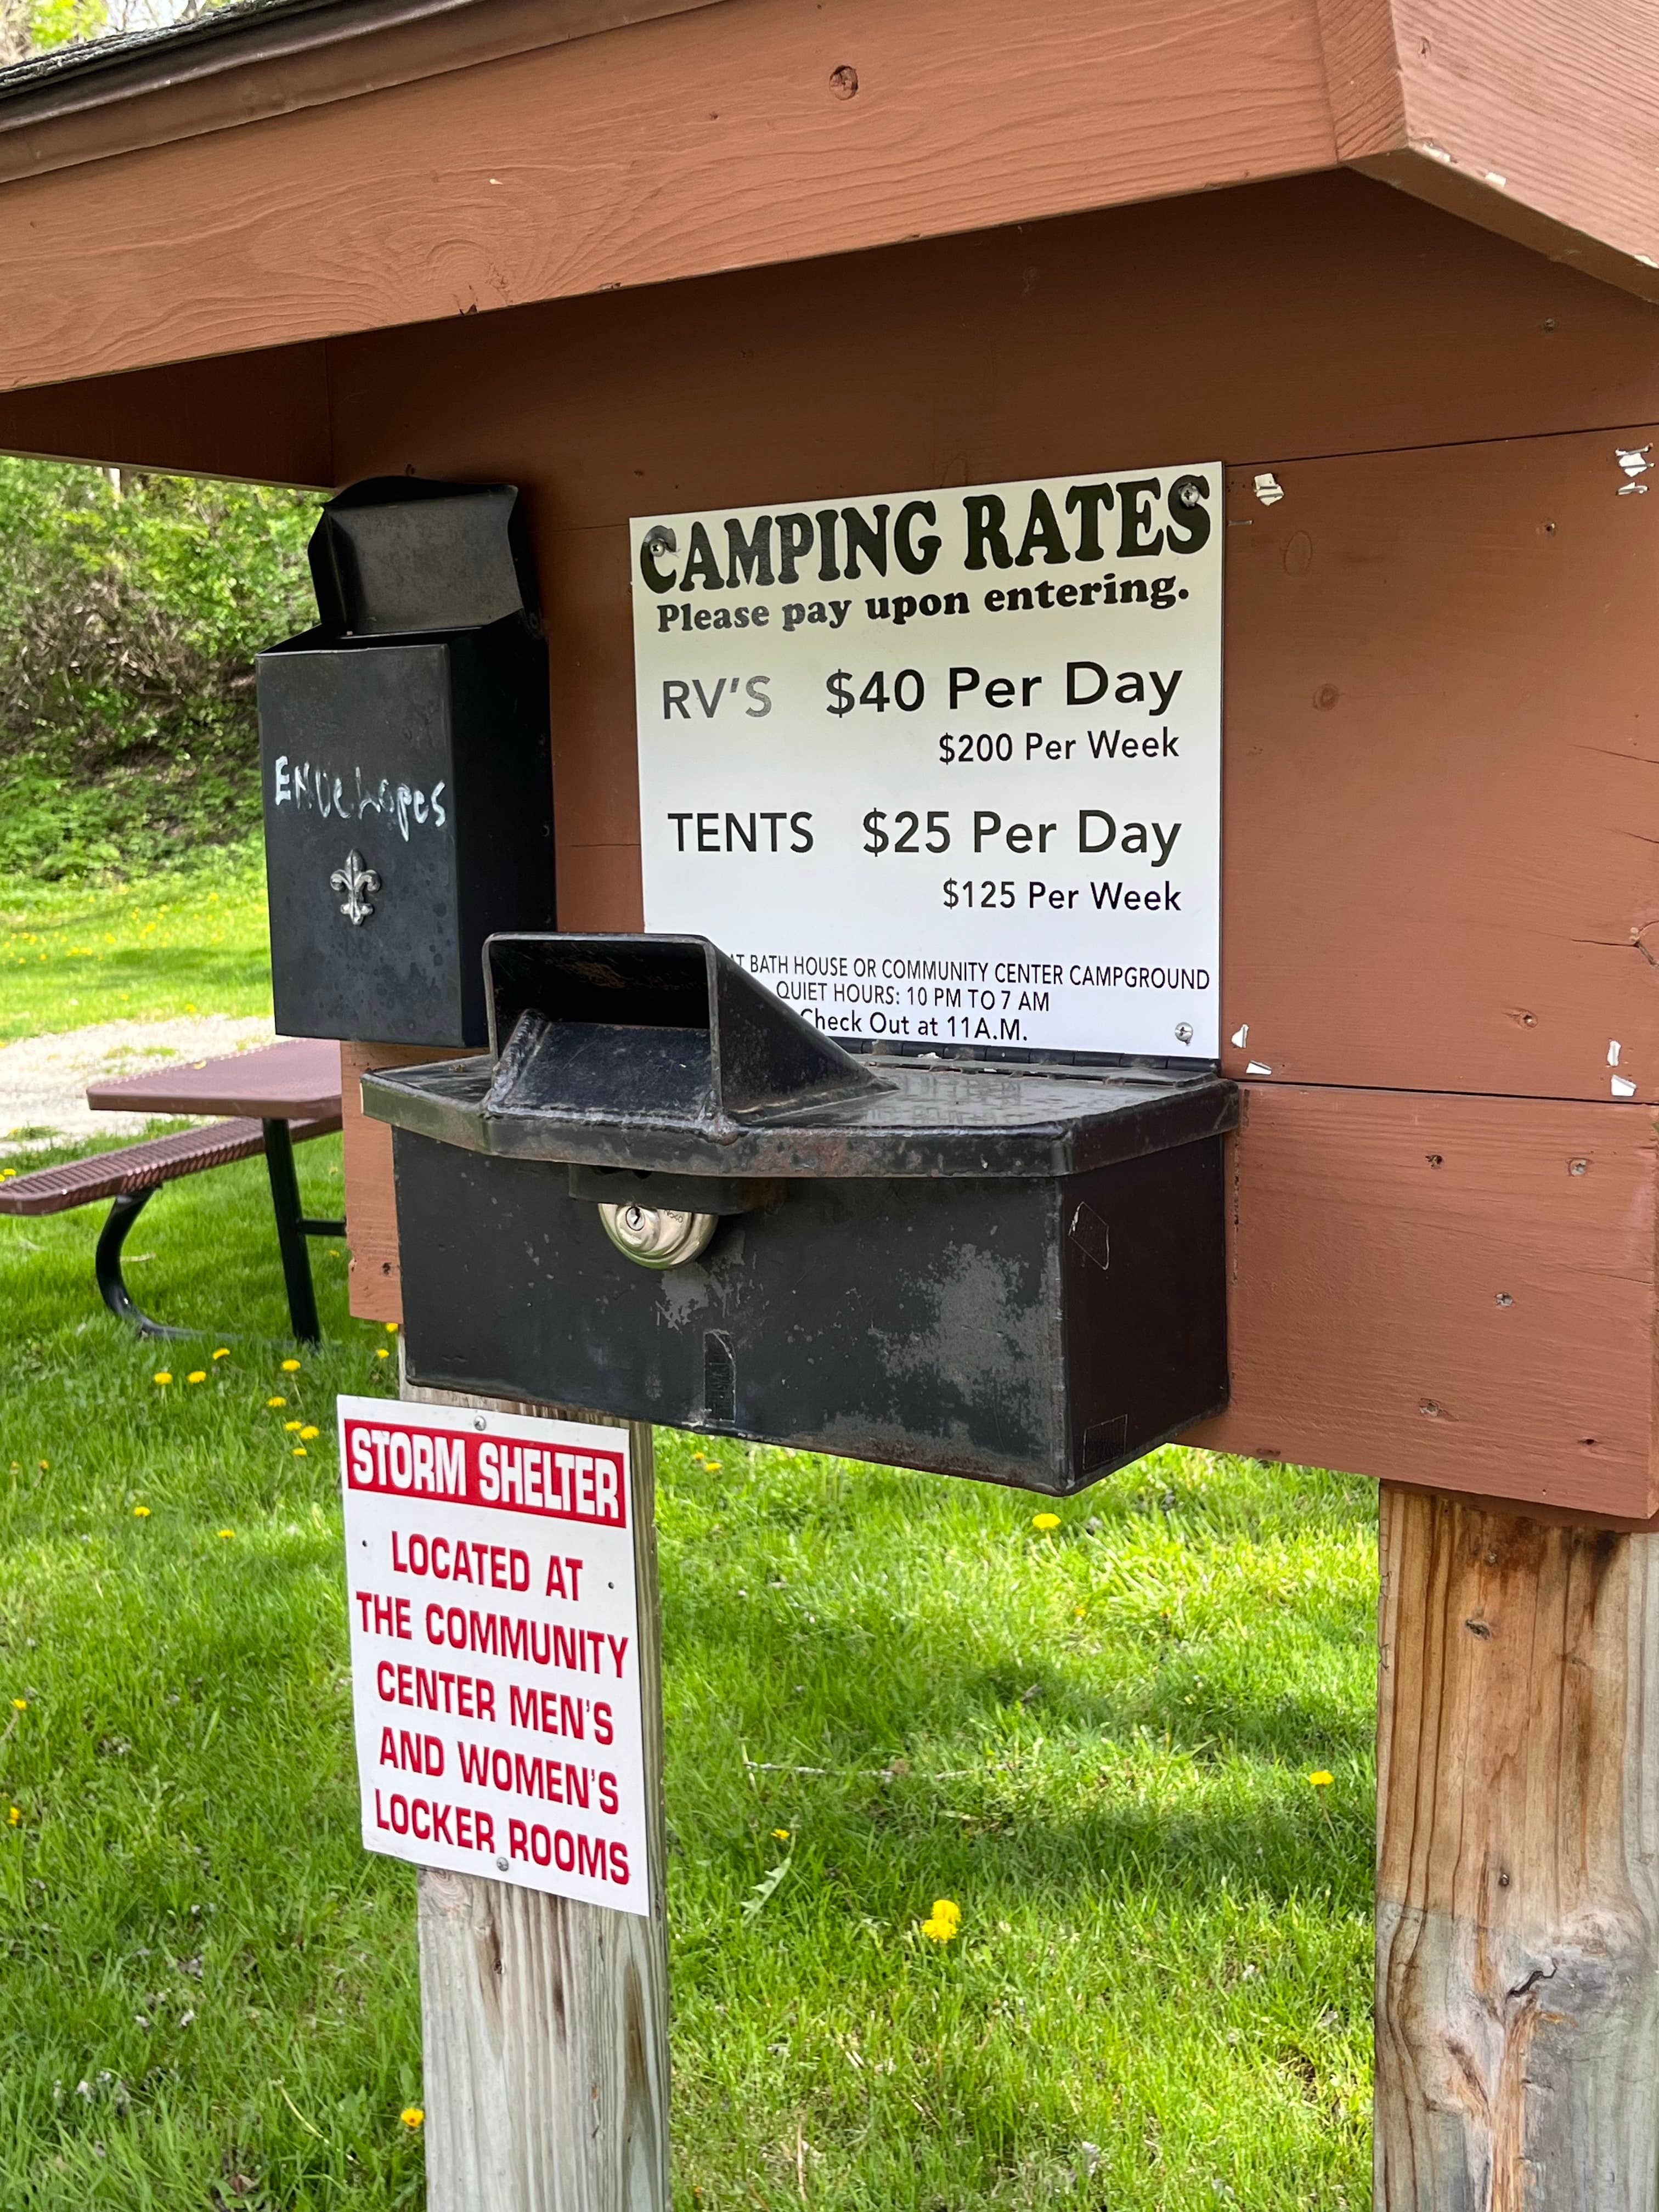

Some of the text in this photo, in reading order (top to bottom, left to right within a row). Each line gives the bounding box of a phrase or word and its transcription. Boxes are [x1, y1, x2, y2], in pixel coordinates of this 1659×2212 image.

[640, 474, 1211, 594] CAMPING RATES
[657, 573, 1189, 633] Please pay upon entering.
[663, 661, 1183, 720] RV'S $40 Per Day
[939, 726, 1180, 765] $200 Per Week
[667, 807, 1182, 867] TENTS $25 Per Day
[943, 877, 1181, 911] $125 Per Week
[751, 954, 788, 974] BATH
[794, 956, 848, 977] HOUSE
[854, 958, 876, 978] OR
[882, 959, 989, 982] COMMUNITY
[995, 963, 1063, 985] CENTER
[1070, 965, 1210, 990] CAMPGROUND
[776, 980, 1049, 1012] QUIET HOURS: 10 PM TO 7 AM
[870, 1012, 910, 1035] Out
[917, 1017, 938, 1036] at
[352, 1427, 624, 1519] STORM SHELTER
[392, 1531, 583, 1601] LOCATED AT
[356, 1591, 628, 1678] THE COMMUNITY
[377, 1661, 614, 1745] CENTER MEN'S
[380, 1726, 619, 1815] AND WOMEN'S
[375, 1789, 630, 1885] LOCKER ROOMS
